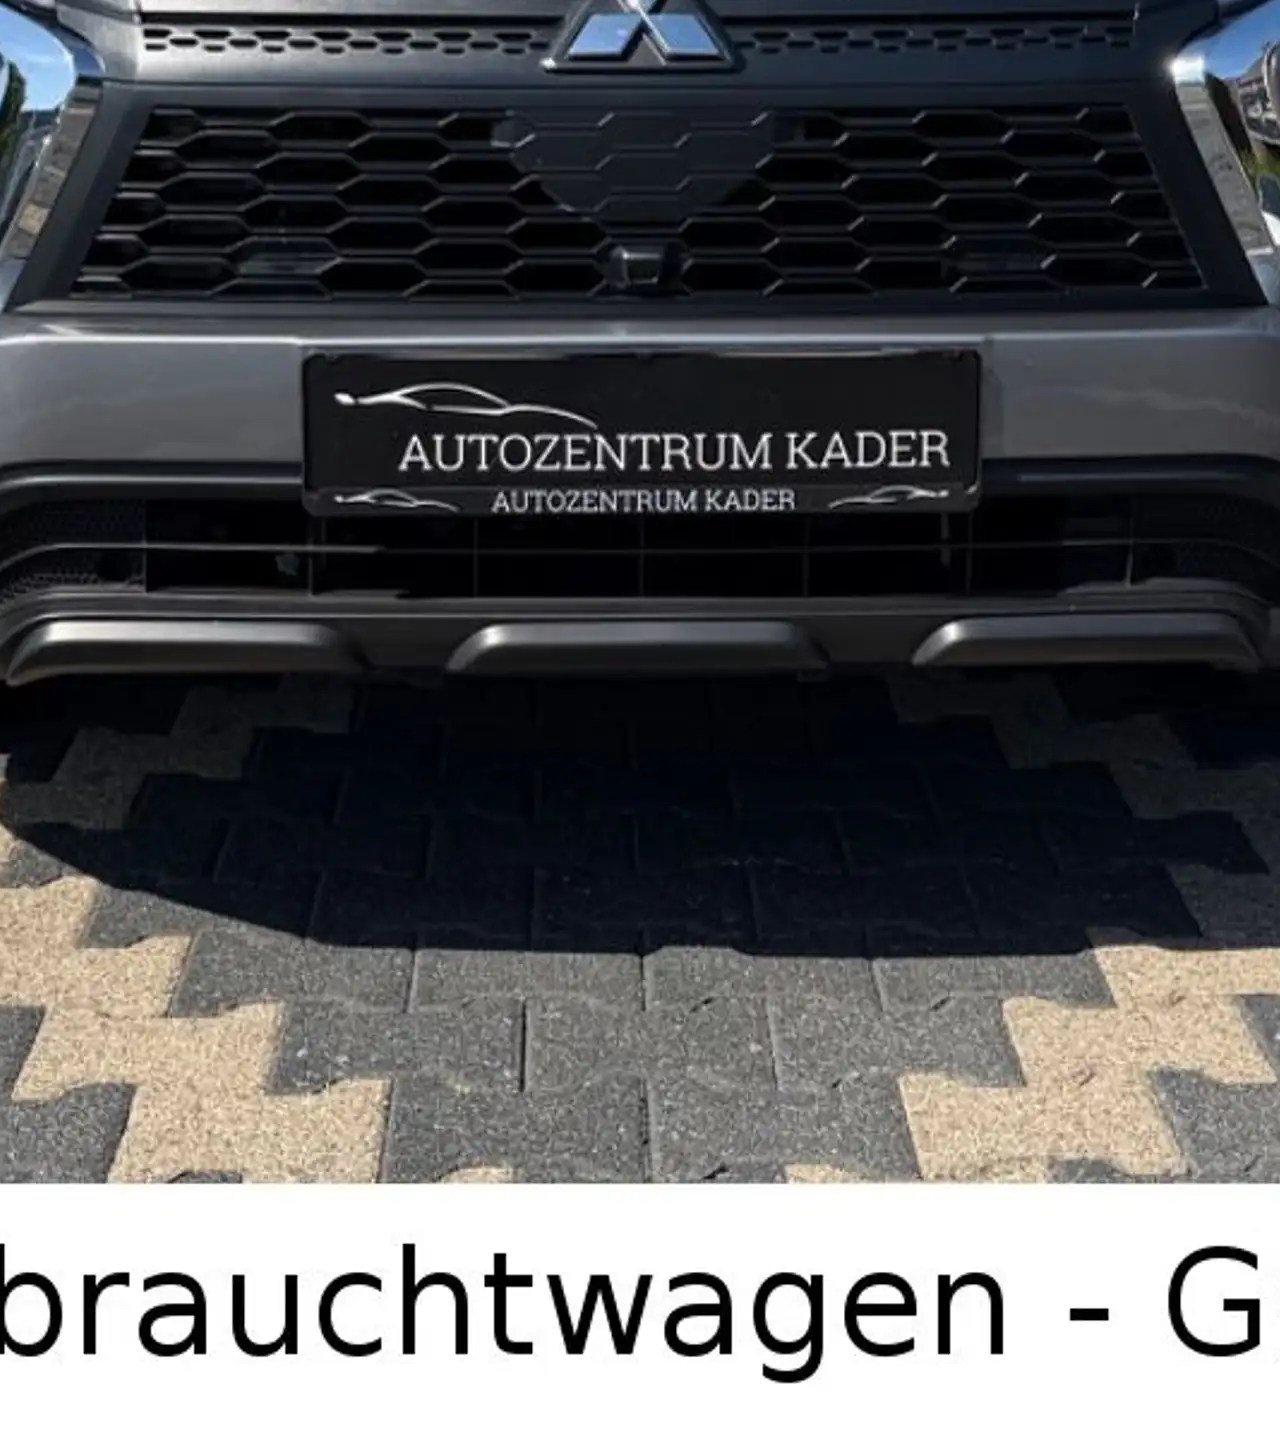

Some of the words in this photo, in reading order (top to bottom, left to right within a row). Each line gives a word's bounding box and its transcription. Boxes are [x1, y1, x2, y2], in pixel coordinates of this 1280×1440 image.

[398, 432, 773, 471] AUTOZENTRUM
[786, 430, 951, 469] KADER
[491, 489, 698, 514] AUTOZENTRUM
[704, 488, 796, 512] KADER
